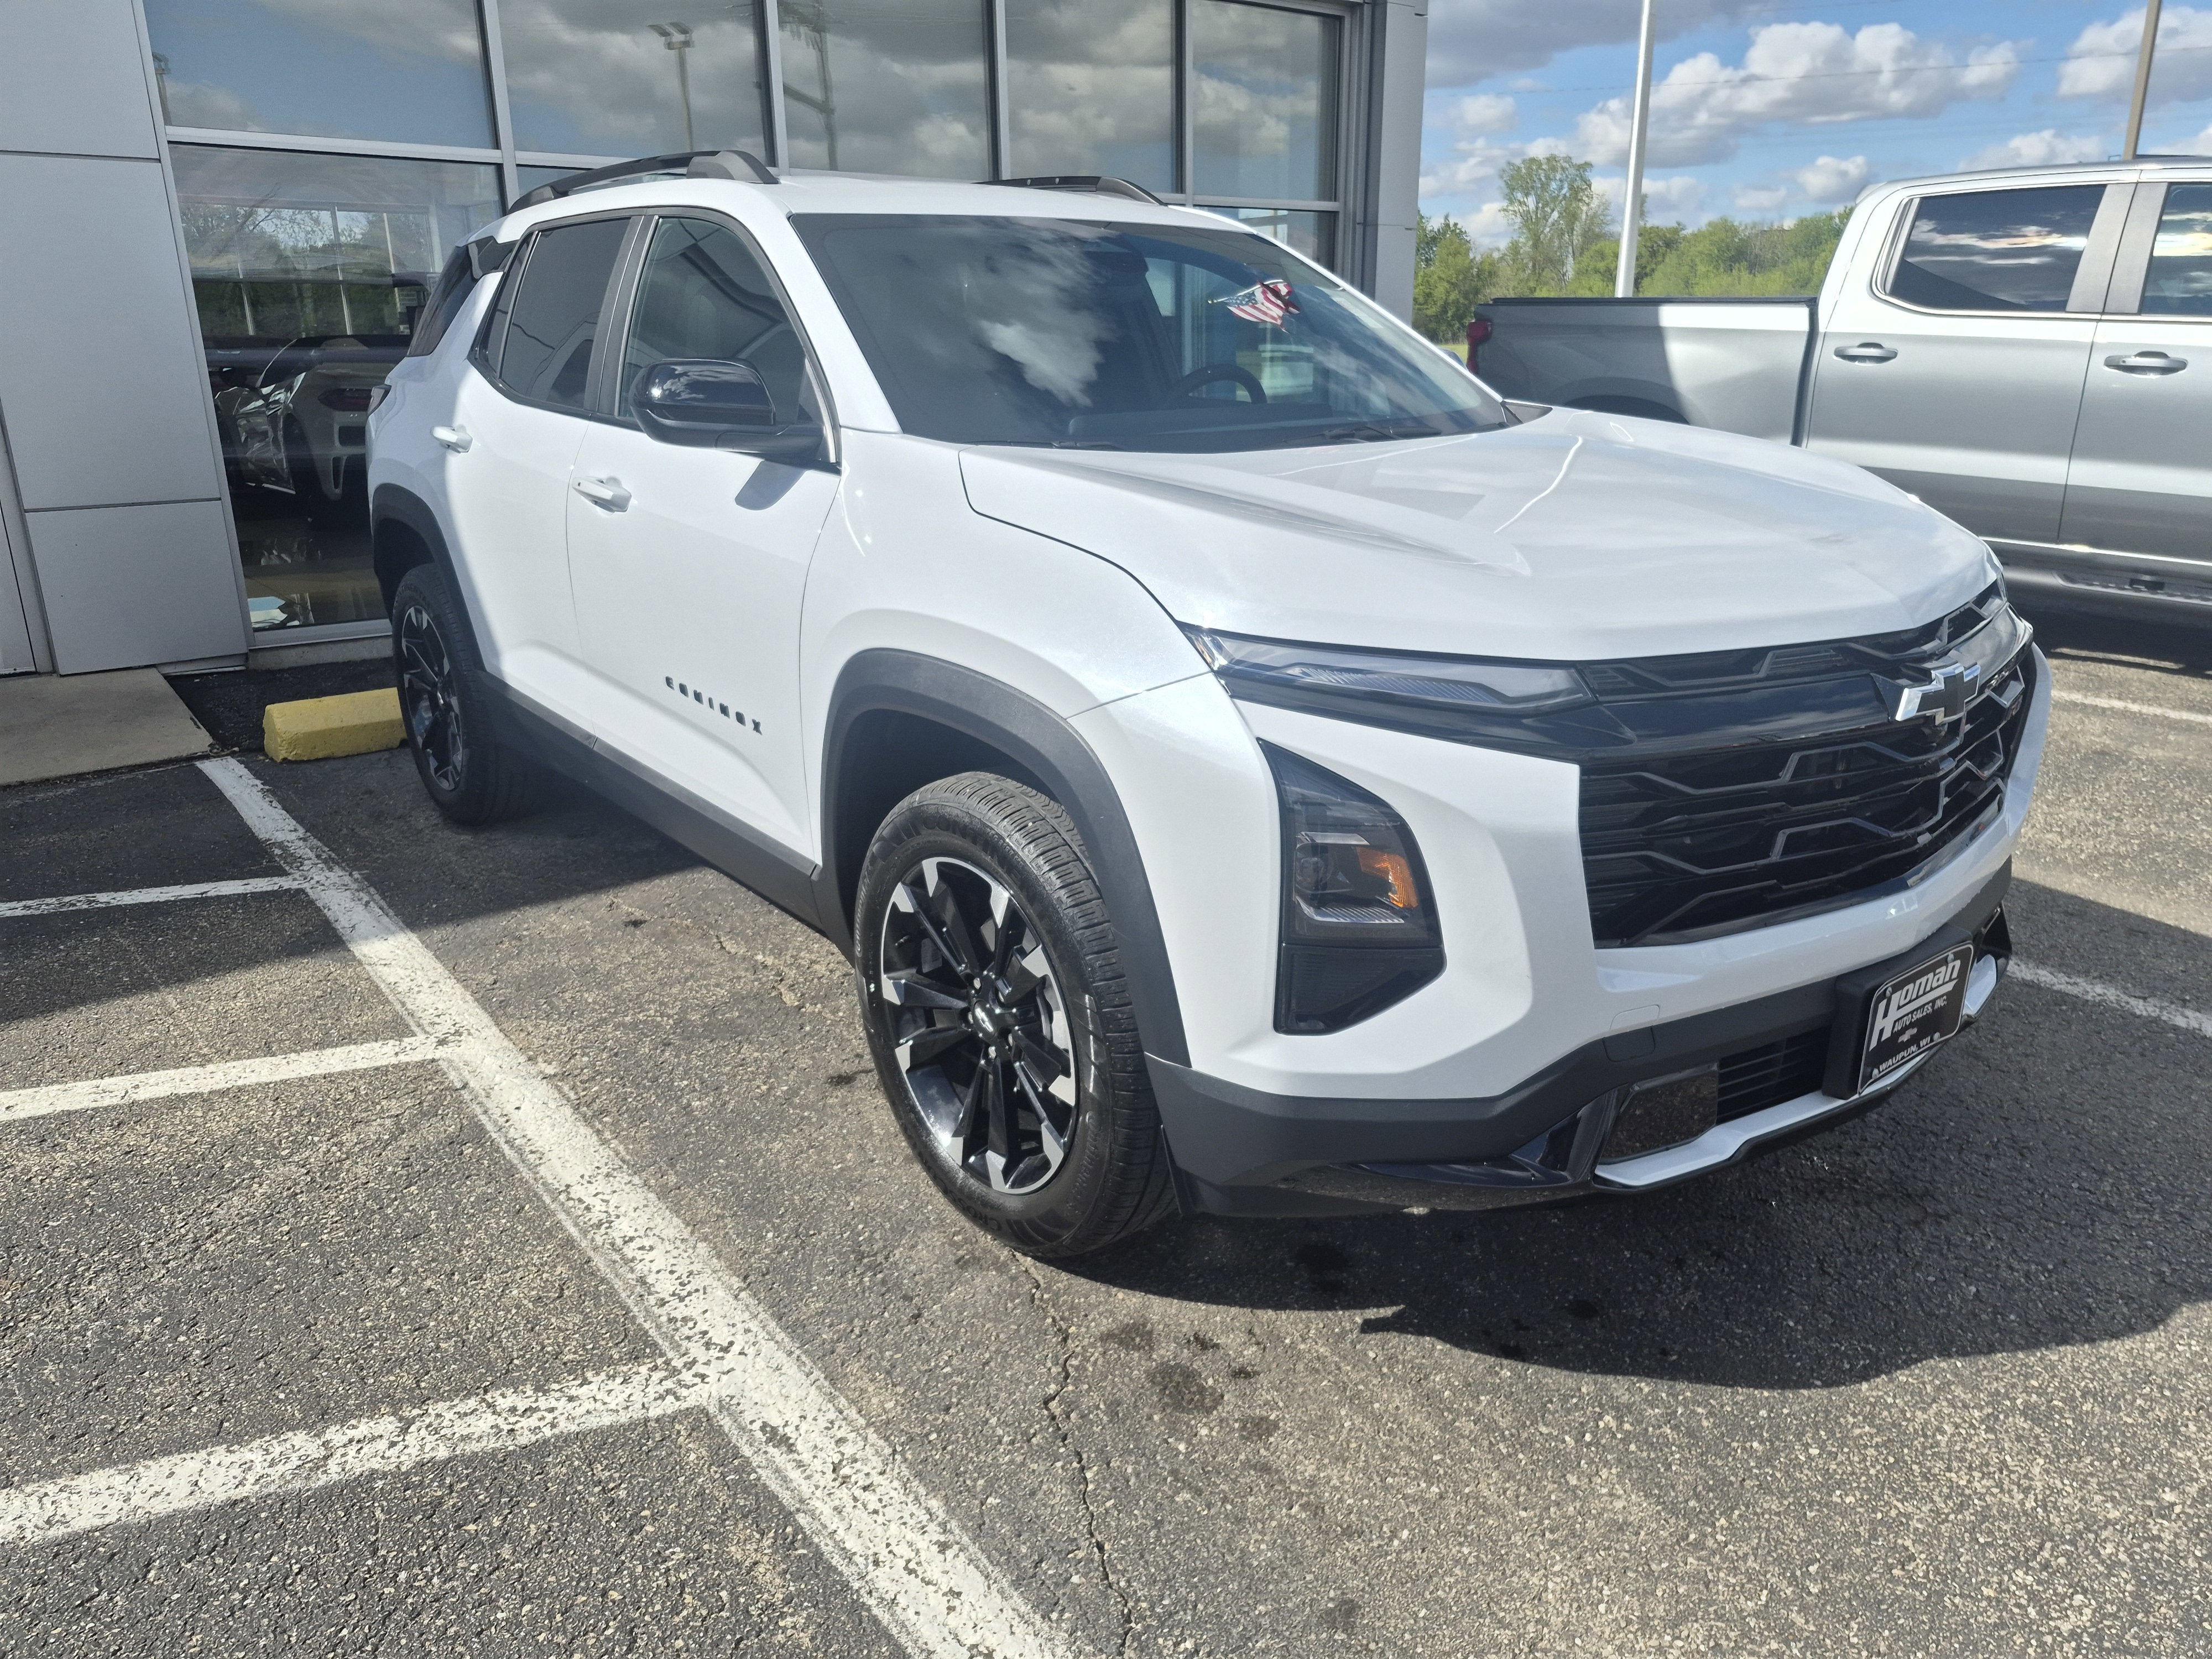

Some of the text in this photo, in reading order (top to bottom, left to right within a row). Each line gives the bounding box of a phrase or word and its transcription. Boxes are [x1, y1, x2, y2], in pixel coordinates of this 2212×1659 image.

[665, 676, 763, 735] EQUINOX
[1893, 1014, 1912, 1033] AUTO
[1934, 995, 1947, 1010] INC.
[1879, 1036, 1931, 1072] WAUPUN, WI
